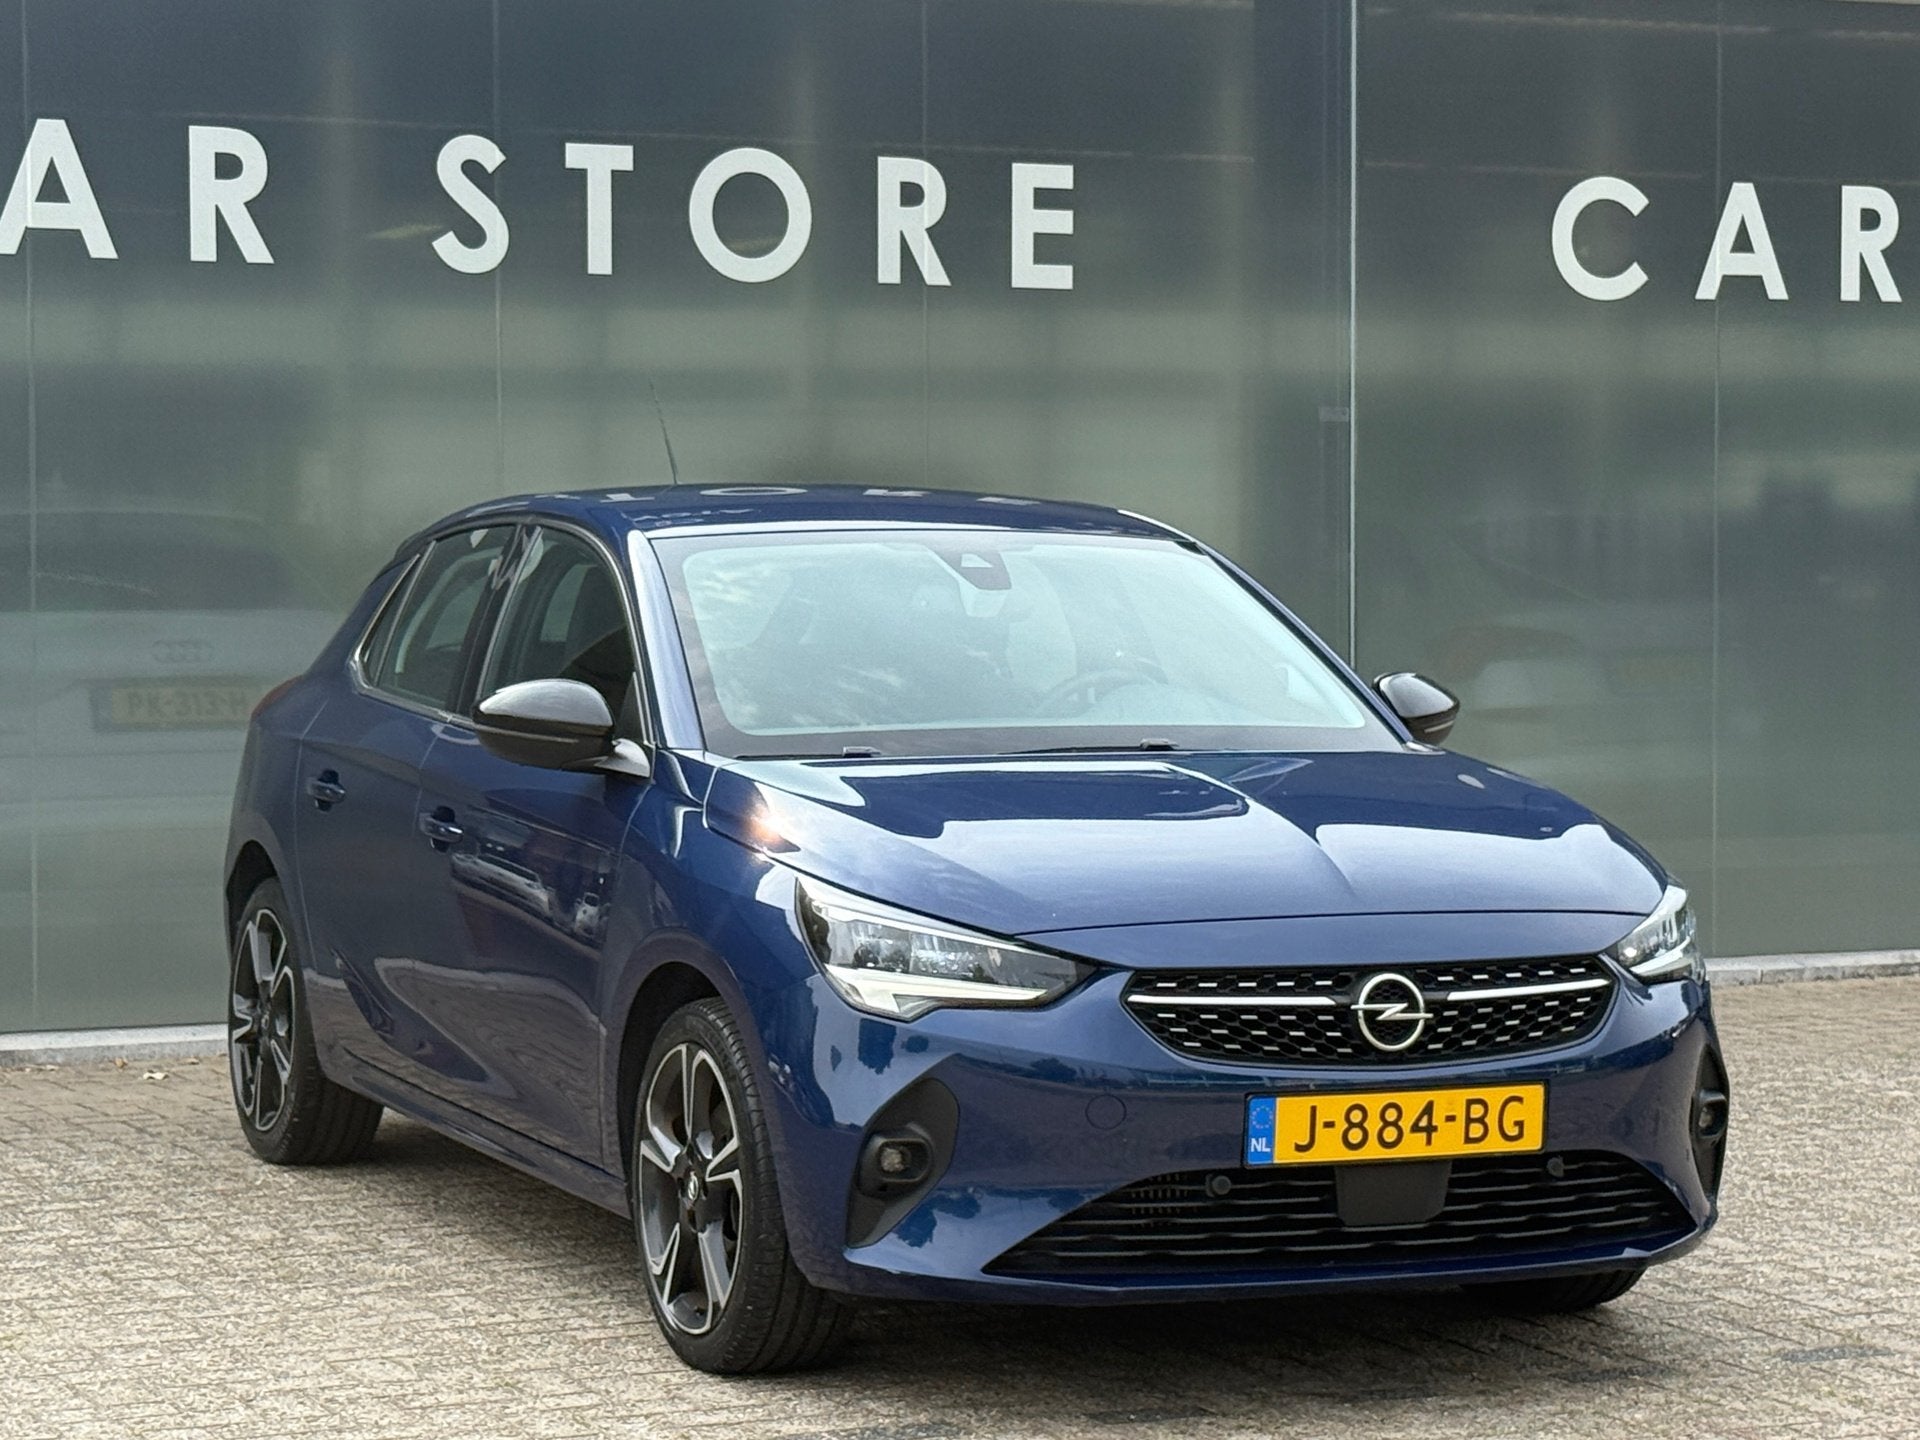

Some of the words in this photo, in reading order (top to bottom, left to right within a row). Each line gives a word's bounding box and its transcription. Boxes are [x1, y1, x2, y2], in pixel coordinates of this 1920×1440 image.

[0, 118, 275, 264] AR
[431, 134, 1074, 290] STORE
[1551, 176, 1903, 303] CAR
[1250, 1136, 1271, 1153] NL
[1293, 1095, 1526, 1153] J-884-BG
